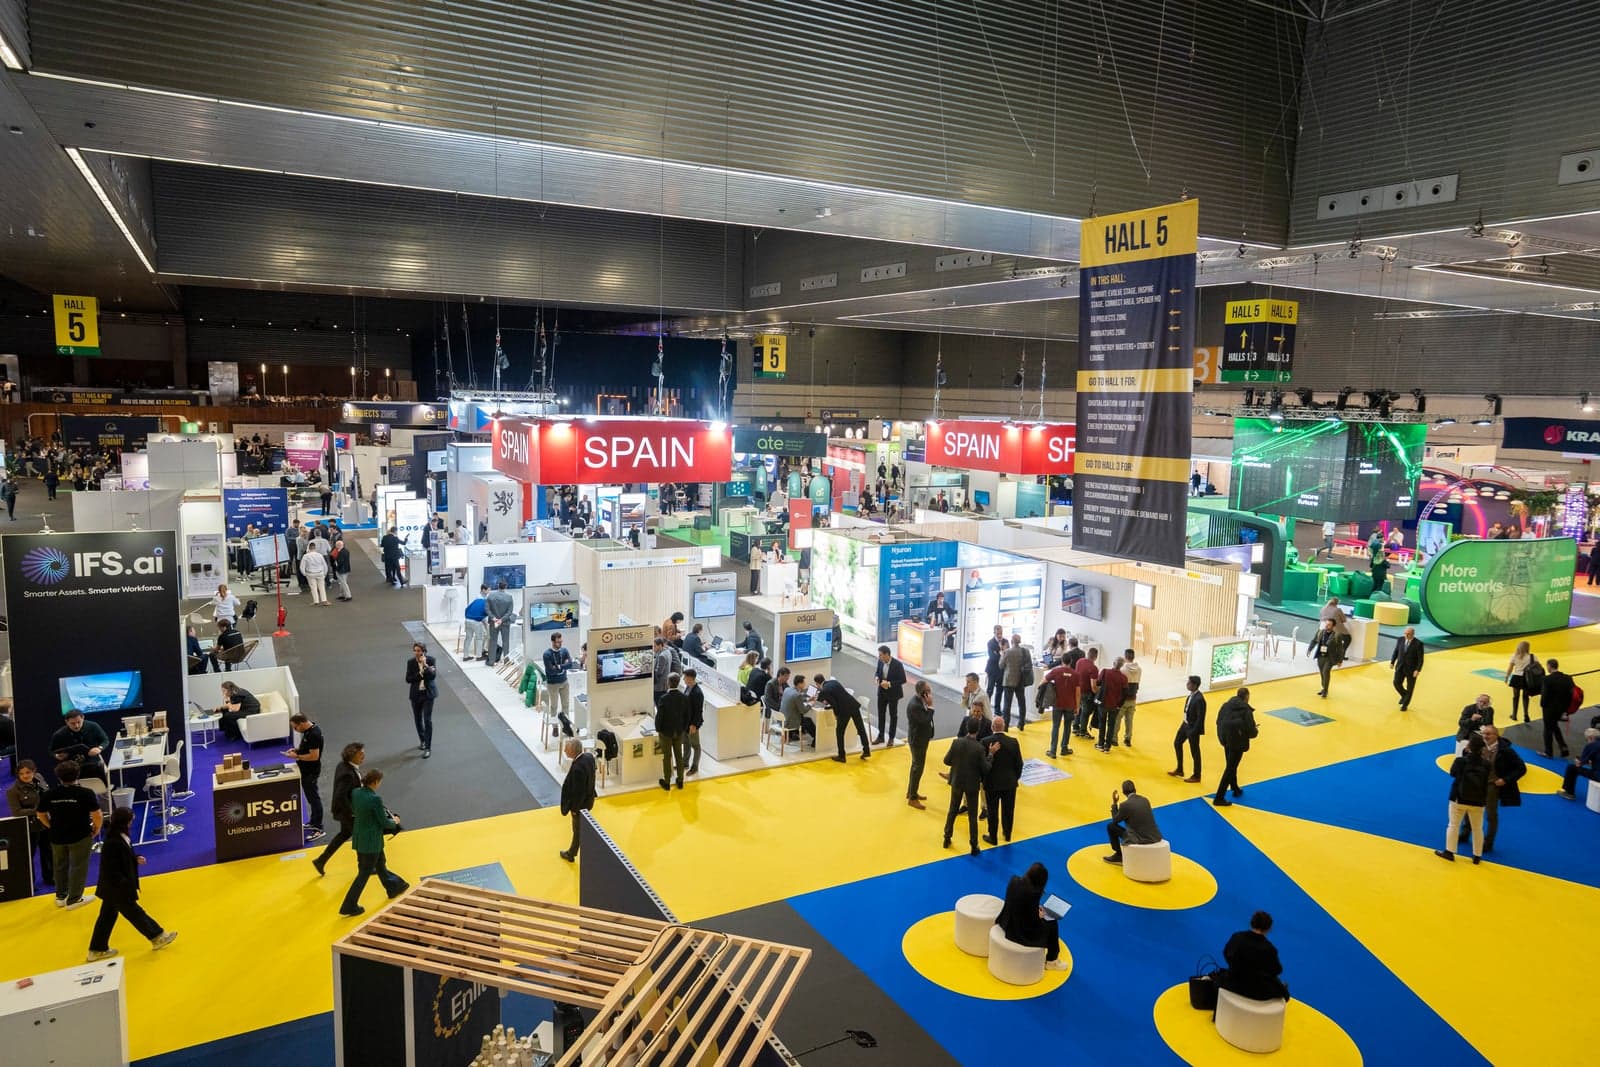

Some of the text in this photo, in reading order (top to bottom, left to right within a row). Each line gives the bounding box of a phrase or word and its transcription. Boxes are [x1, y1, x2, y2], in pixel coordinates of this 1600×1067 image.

[1106, 216, 1168, 254] HALL 5
[1098, 274, 1110, 285] THIS
[64, 299, 86, 310] HALL
[1231, 304, 1260, 318] HALL 5
[1288, 306, 1293, 319] 5
[68, 312, 86, 342] 5
[770, 347, 779, 368] 5
[1228, 352, 1246, 362] HALLS
[1088, 377, 1097, 386] GO
[1097, 377, 1105, 386] TO
[1105, 377, 1119, 386] HALL
[500, 430, 528, 464] SPAIN
[757, 436, 784, 450] ate
[944, 432, 1000, 460] SPAIN
[584, 436, 694, 468] SPAIN
[74, 548, 164, 577] IFS.ai
[1440, 563, 1478, 577] More
[1439, 580, 1504, 593] networks
[1550, 576, 1571, 587] more
[24, 584, 165, 598] Smarter Assets. Smarter Workforce.
[1545, 591, 1570, 604] future
[247, 794, 298, 817] IFS.ai
[227, 824, 263, 835] Utilities.ai
[271, 819, 290, 828] IFS.ai
